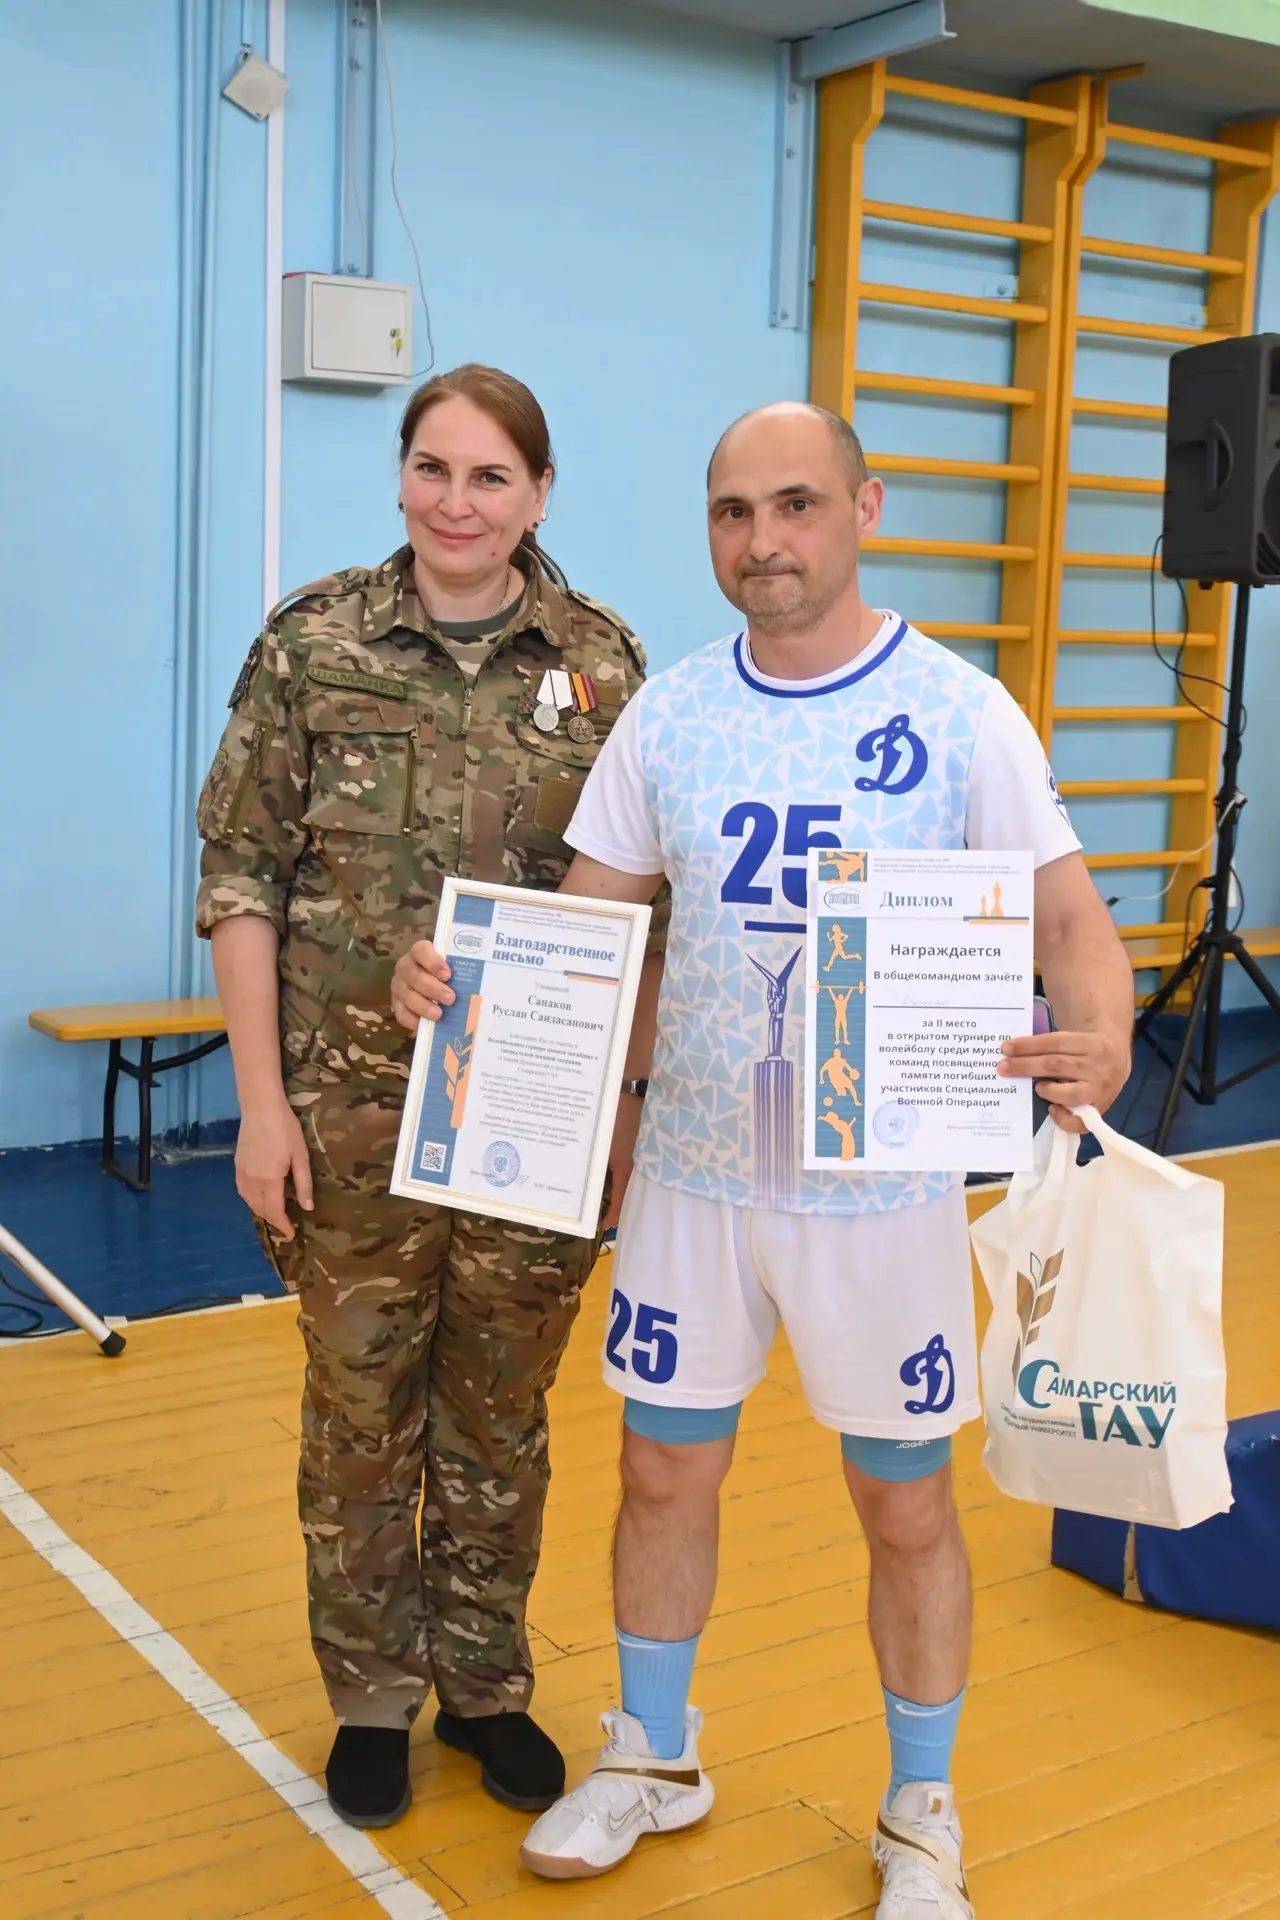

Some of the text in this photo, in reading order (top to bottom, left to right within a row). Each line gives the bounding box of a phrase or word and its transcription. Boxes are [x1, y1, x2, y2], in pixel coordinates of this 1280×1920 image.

[721, 801, 842, 908] 25
[879, 891, 953, 909] Диплом
[495, 931, 616, 962] Благодарственное
[890, 944, 1001, 959] Награждается
[492, 949, 544, 966] письмо
[873, 970, 1023, 983] В общекомандном зачёте
[527, 994, 572, 1012] Санаков
[492, 1004, 527, 1020] Руслан
[921, 1020, 934, 1028] за
[945, 1020, 977, 1028] место
[896, 1033, 950, 1042] открытом
[952, 1034, 996, 1043] турнире
[879, 1044, 1002, 1056] волейболу среди мужс
[889, 1059, 930, 1068] команд
[901, 1070, 997, 1081] памяти погибших
[880, 1084, 1017, 1095] участников Специальной
[897, 1096, 1001, 1108] Военной Операции
[606, 1287, 678, 1384] 25
[1078, 1401, 1176, 1449] ГАУ
